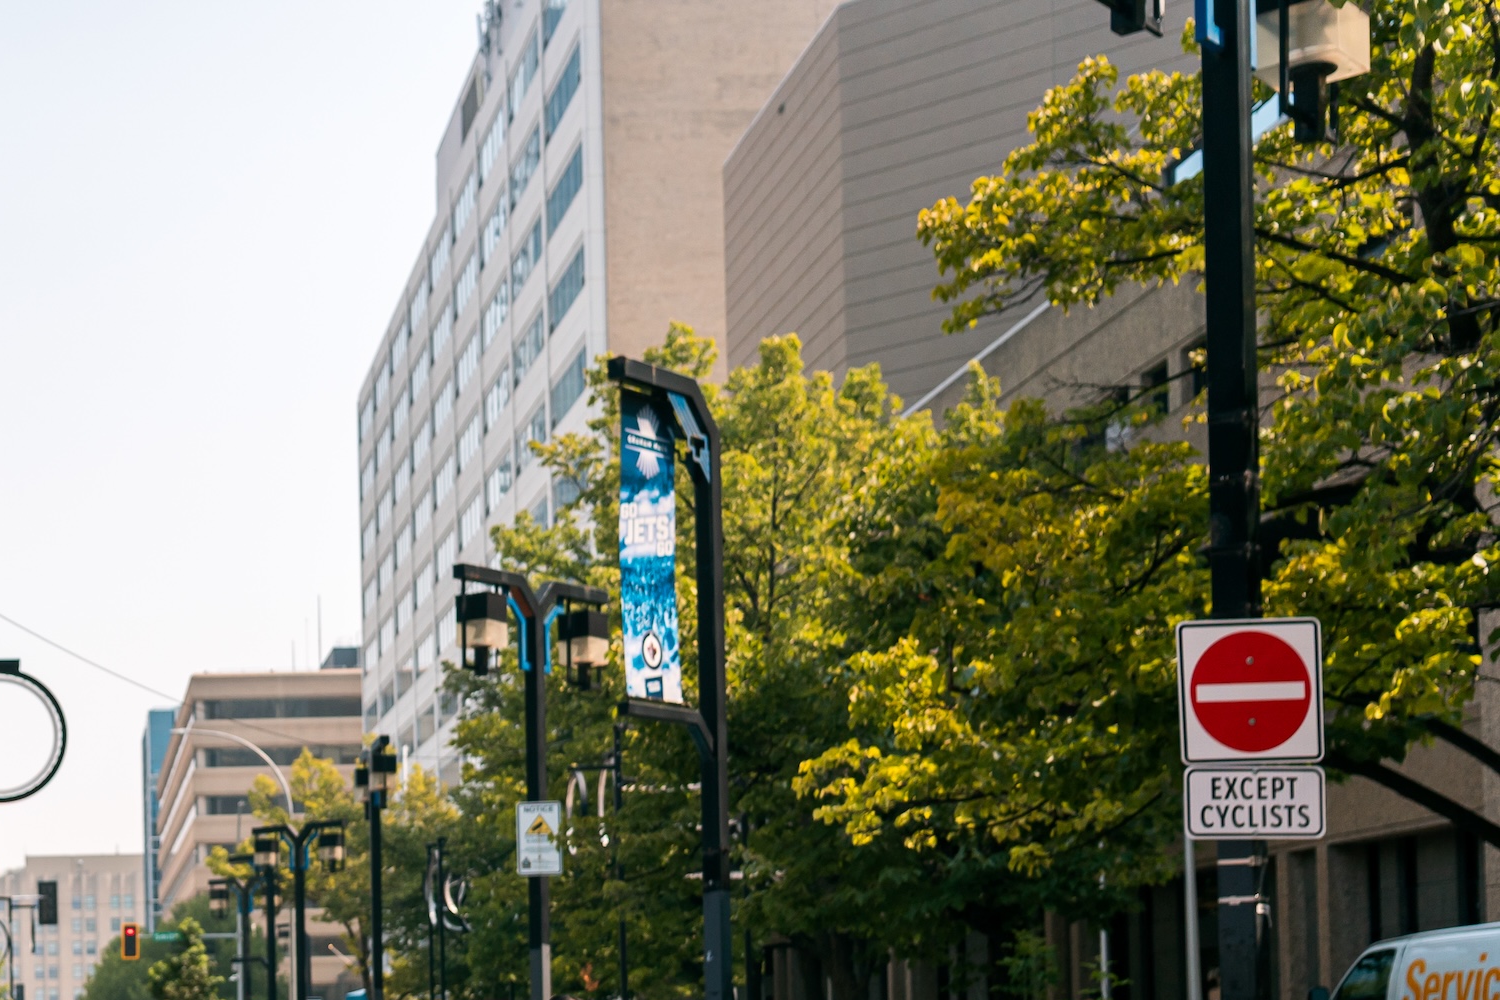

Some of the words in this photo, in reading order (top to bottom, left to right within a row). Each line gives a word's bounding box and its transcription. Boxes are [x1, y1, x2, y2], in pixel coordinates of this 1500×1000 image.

[620, 502, 638, 520] GO
[624, 515, 669, 546] JETS
[656, 540, 674, 558] GO
[1211, 776, 1298, 801] EXCEPT
[1200, 804, 1311, 828] CYCLISTS
